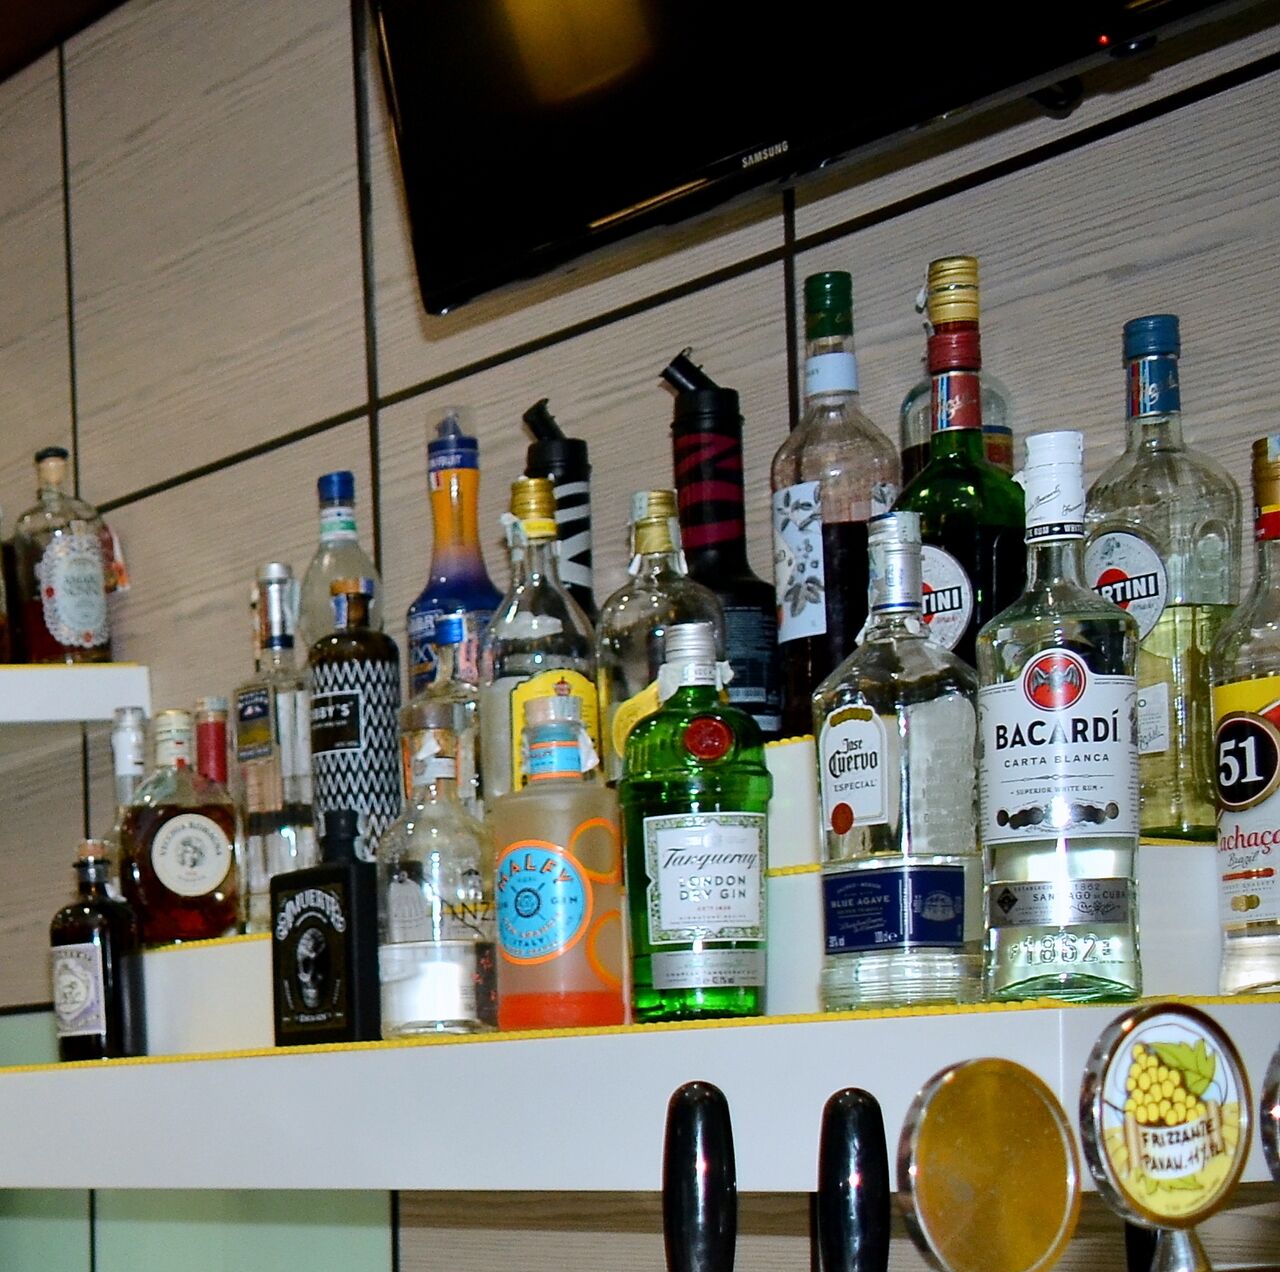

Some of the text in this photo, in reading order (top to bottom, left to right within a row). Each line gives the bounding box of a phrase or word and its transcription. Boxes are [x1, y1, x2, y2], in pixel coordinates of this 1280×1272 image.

[742, 140, 788, 168] SAMSUNG
[1093, 574, 1155, 604] RTINI
[922, 588, 959, 615] TINI
[995, 708, 1119, 750] BACARDÍ
[842, 737, 863, 754] Jose
[828, 749, 878, 779] Cuervo
[1004, 753, 1110, 769] CARTA BLANCA
[1218, 734, 1264, 788] 51
[833, 779, 876, 792] ESPECIAL
[1015, 786, 1053, 796] SUPERIOR
[1082, 784, 1099, 793] RUM
[663, 848, 758, 871] Tanqueray
[498, 853, 574, 892] MALFY
[679, 875, 747, 890] LONDON
[679, 888, 747, 901] DRY GIN
[831, 894, 891, 909] BLUE AGAVE
[1032, 890, 1092, 902] SANAGO
[1022, 932, 1099, 965] 1862
